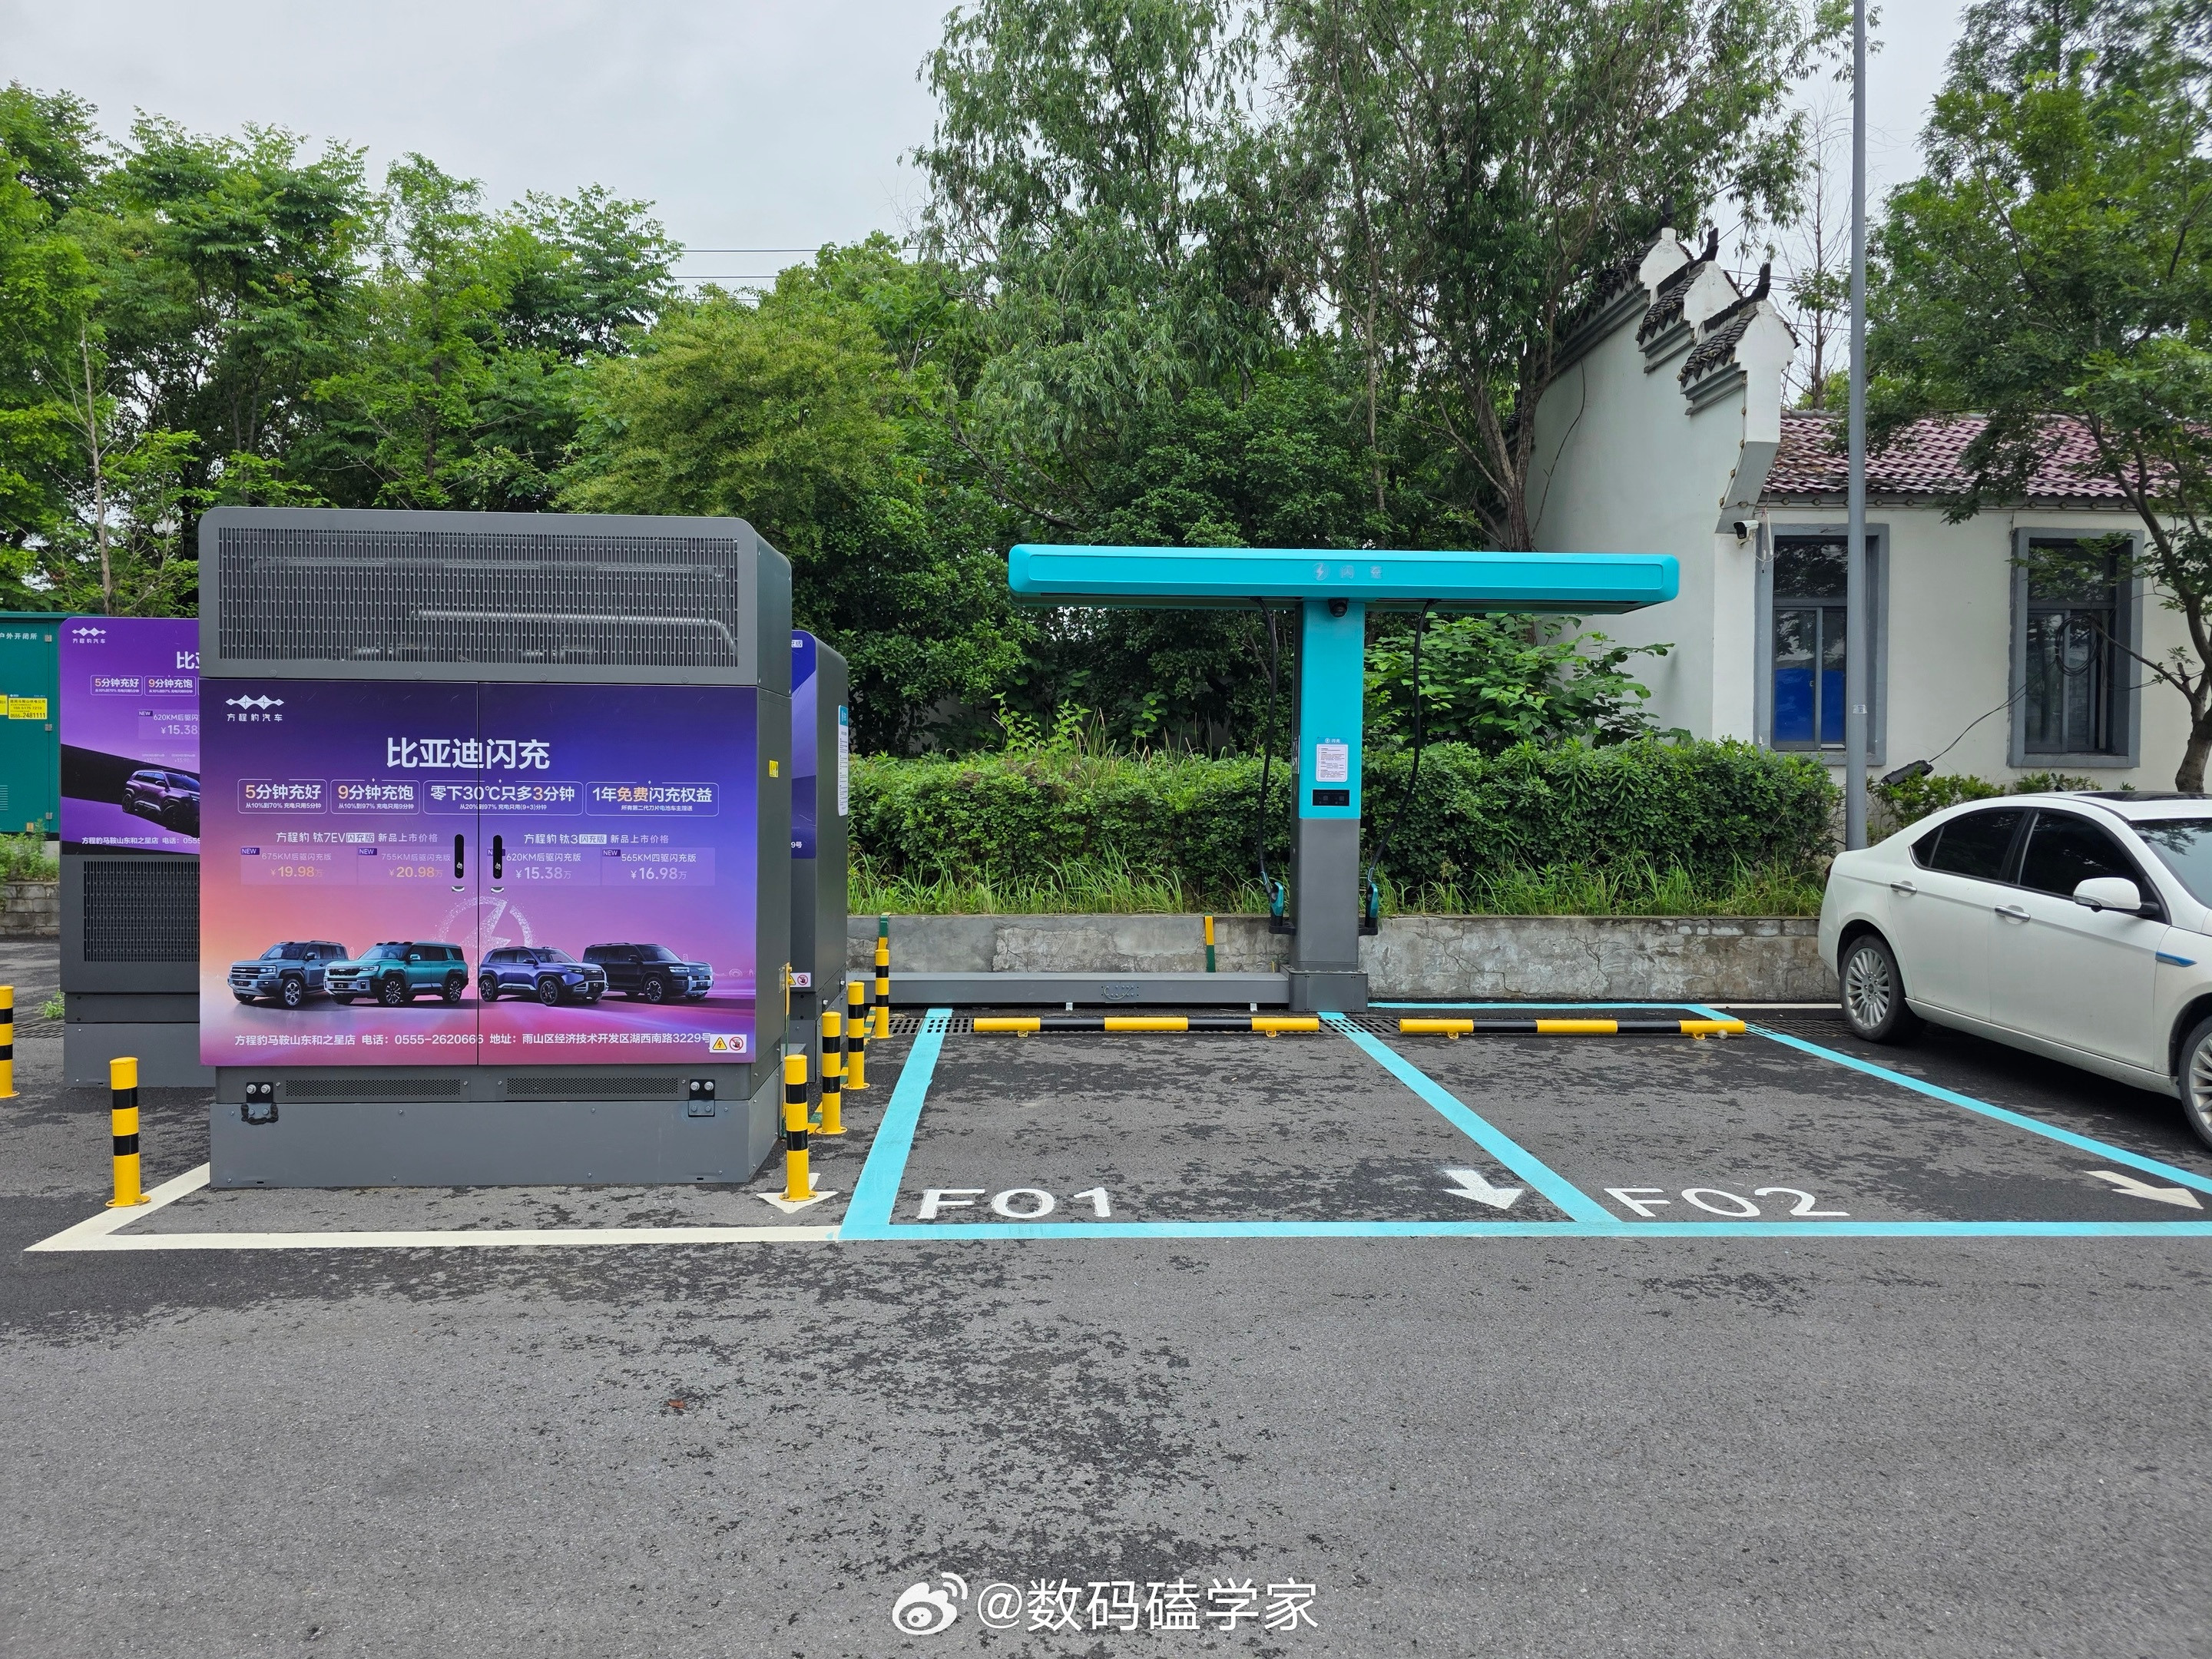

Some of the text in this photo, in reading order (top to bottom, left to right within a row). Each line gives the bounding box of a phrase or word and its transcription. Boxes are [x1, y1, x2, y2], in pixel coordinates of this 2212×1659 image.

[177, 651, 200, 669] 比
[94, 678, 140, 687] 5分钟充好
[148, 679, 194, 688] 9分钟充饱
[227, 714, 283, 722] 方程豹汽车
[386, 737, 550, 770] 比亚迪闪充
[245, 784, 321, 800] 5分钟充好
[338, 785, 414, 800] 9分钟充饱
[592, 786, 713, 803] 1年免费闪充权益
[276, 833, 310, 843] 方程豹
[378, 833, 438, 843] 新品上市价格
[524, 833, 557, 844] 方程豹
[610, 834, 669, 843] 新品上市价格
[261, 853, 332, 861] 675KM后驱闪充版
[381, 853, 451, 862] 755KM后驱闪充版
[506, 853, 581, 862] 620KM后驱闪充版
[621, 853, 697, 863] 565KM四驱闪充版
[234, 1035, 356, 1045] 方程豹马鞍山东和之星店
[916, 1187, 1111, 1219] F01
[1603, 1187, 1851, 1218] F02
